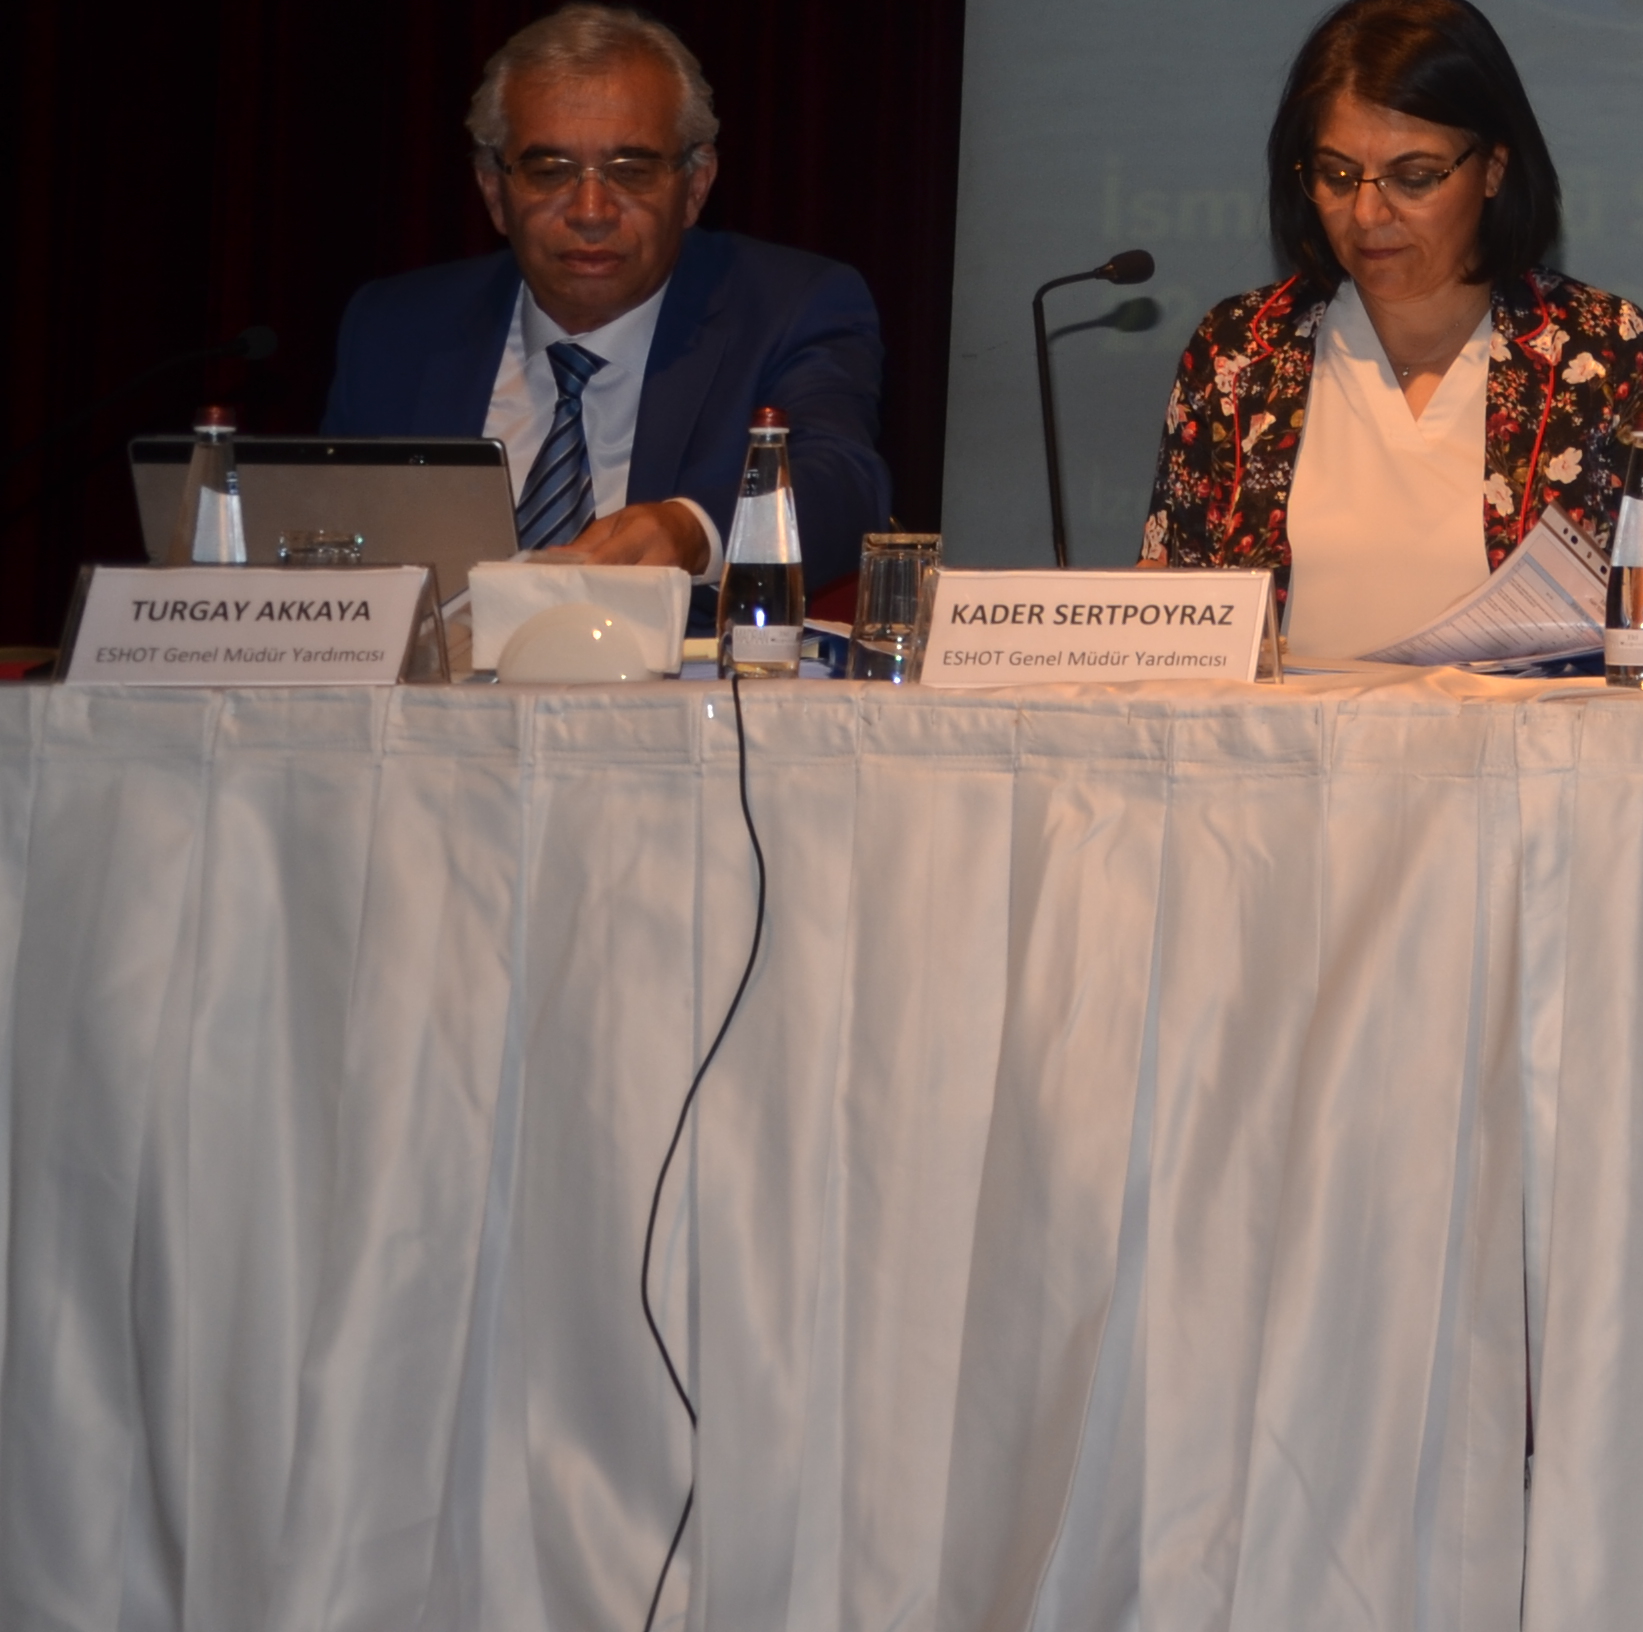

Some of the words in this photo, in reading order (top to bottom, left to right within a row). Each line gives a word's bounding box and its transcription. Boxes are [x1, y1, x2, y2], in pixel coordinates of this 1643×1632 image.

[131, 600, 252, 623] TURGAY
[256, 600, 371, 623] AKKAYA
[951, 603, 1045, 626] KADER
[1052, 603, 1235, 626] SERTPOYRAZ
[95, 646, 159, 665] ESHOT
[162, 647, 219, 665] Genel
[223, 646, 287, 665] Müdür
[291, 646, 385, 665] Yardımcısı
[942, 650, 1005, 667] ESHOT
[1008, 650, 1063, 667] Genel
[1068, 649, 1130, 667] Müdür
[1134, 650, 1227, 668] Yardımcısı
